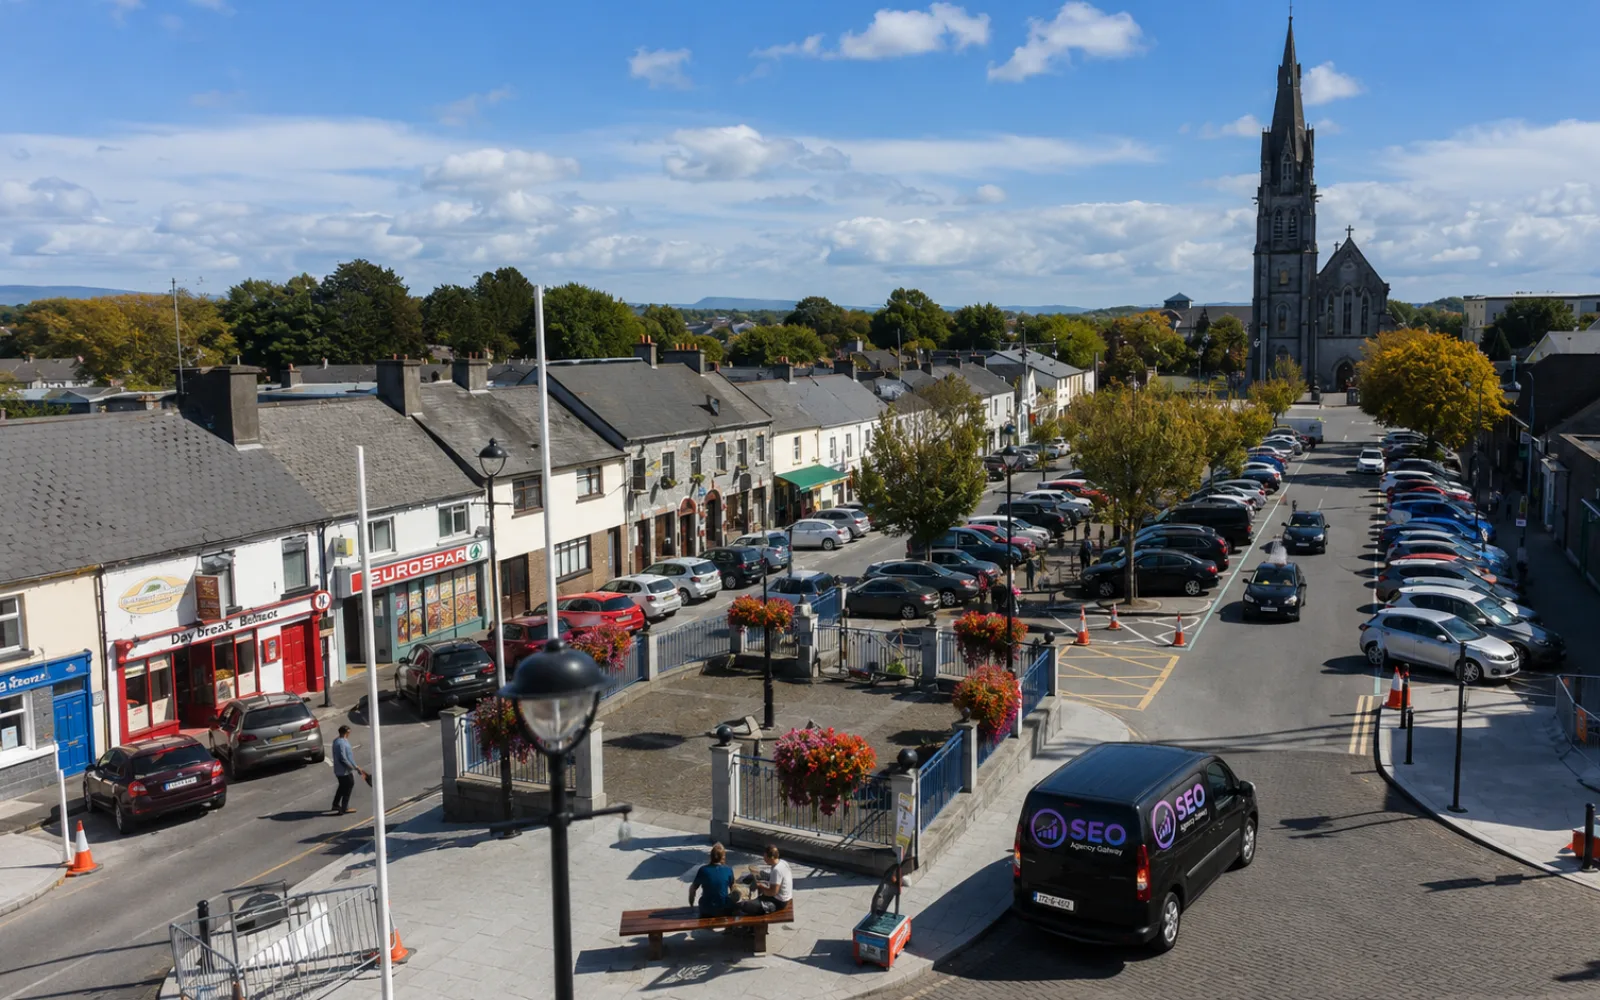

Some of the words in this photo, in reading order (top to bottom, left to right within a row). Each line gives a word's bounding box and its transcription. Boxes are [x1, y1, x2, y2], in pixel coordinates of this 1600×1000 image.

[371, 550, 465, 583] EUROSPAR
[171, 631, 195, 645] Day
[1176, 783, 1205, 820] SEO
[1070, 819, 1126, 845] SEO
